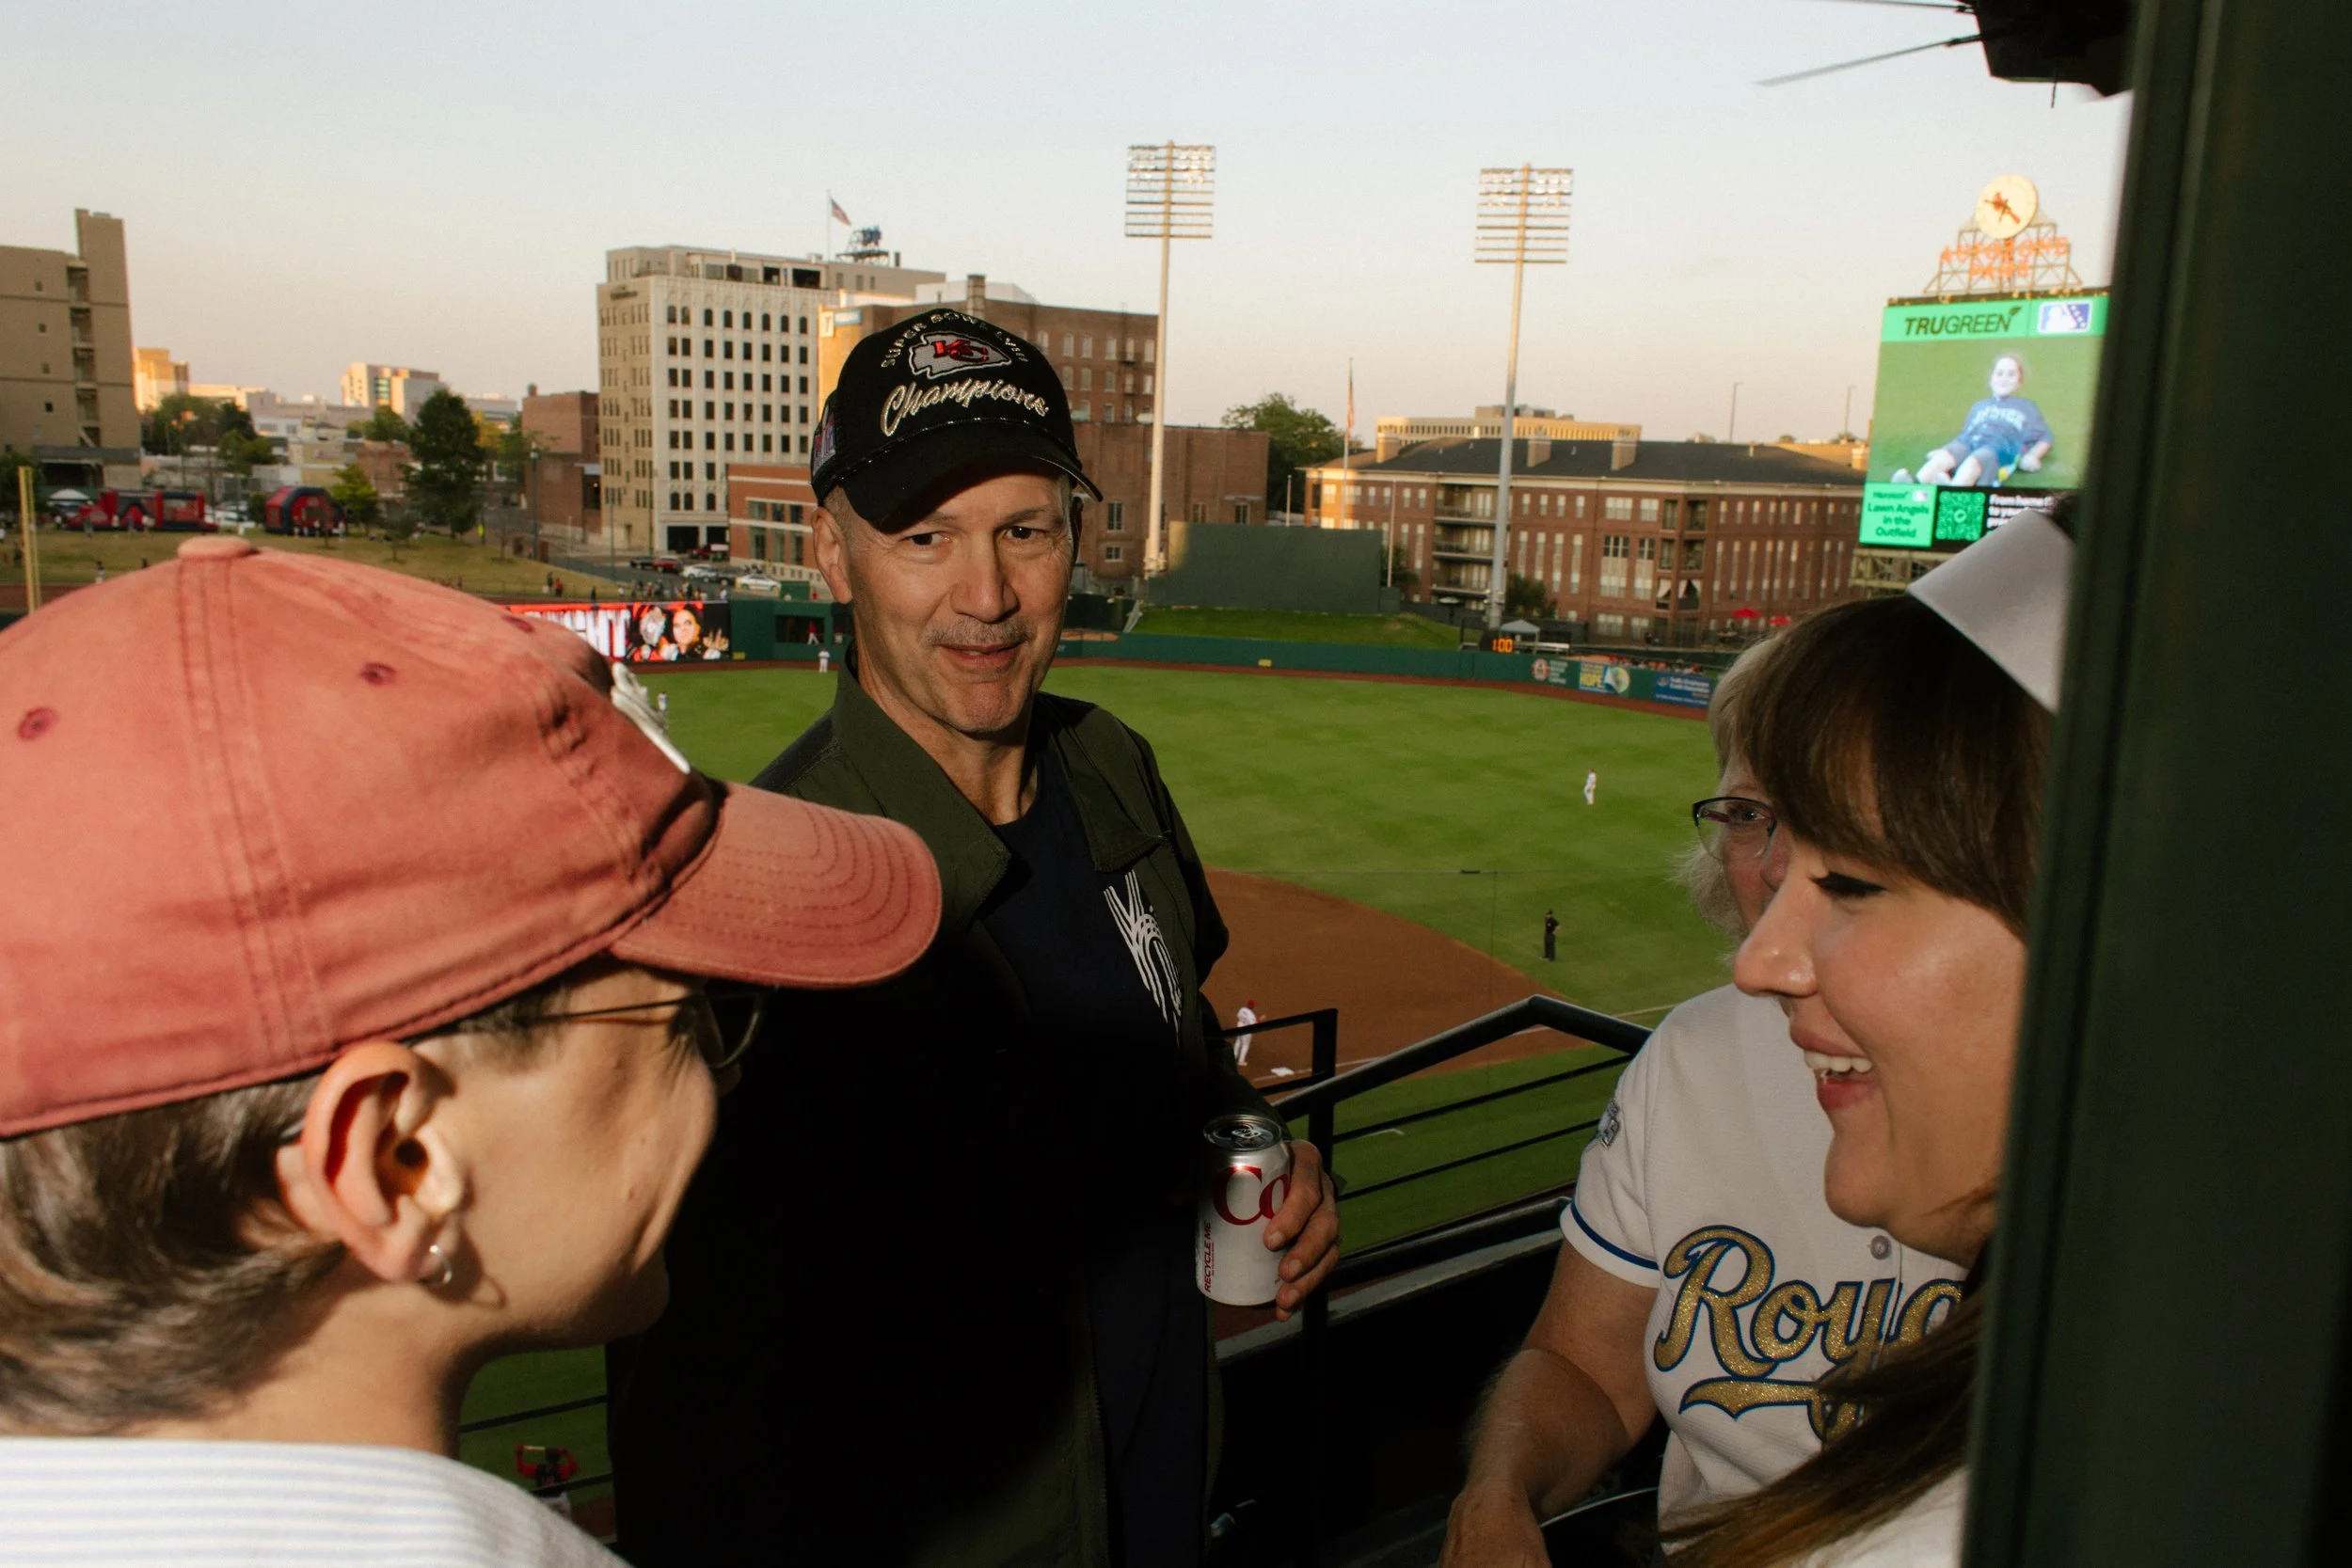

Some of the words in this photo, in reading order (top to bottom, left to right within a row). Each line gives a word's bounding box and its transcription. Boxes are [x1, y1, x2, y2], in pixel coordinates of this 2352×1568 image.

[1904, 313, 2012, 336] TRUGREEN
[881, 322, 927, 368] SUPER
[930, 311, 989, 332] BOWL
[930, 340, 991, 363] KC
[881, 377, 1046, 437] Champions
[1875, 526, 1916, 538] Outfield
[1203, 1221, 1212, 1240] ME
[1203, 1240, 1213, 1293] RECYCLE
